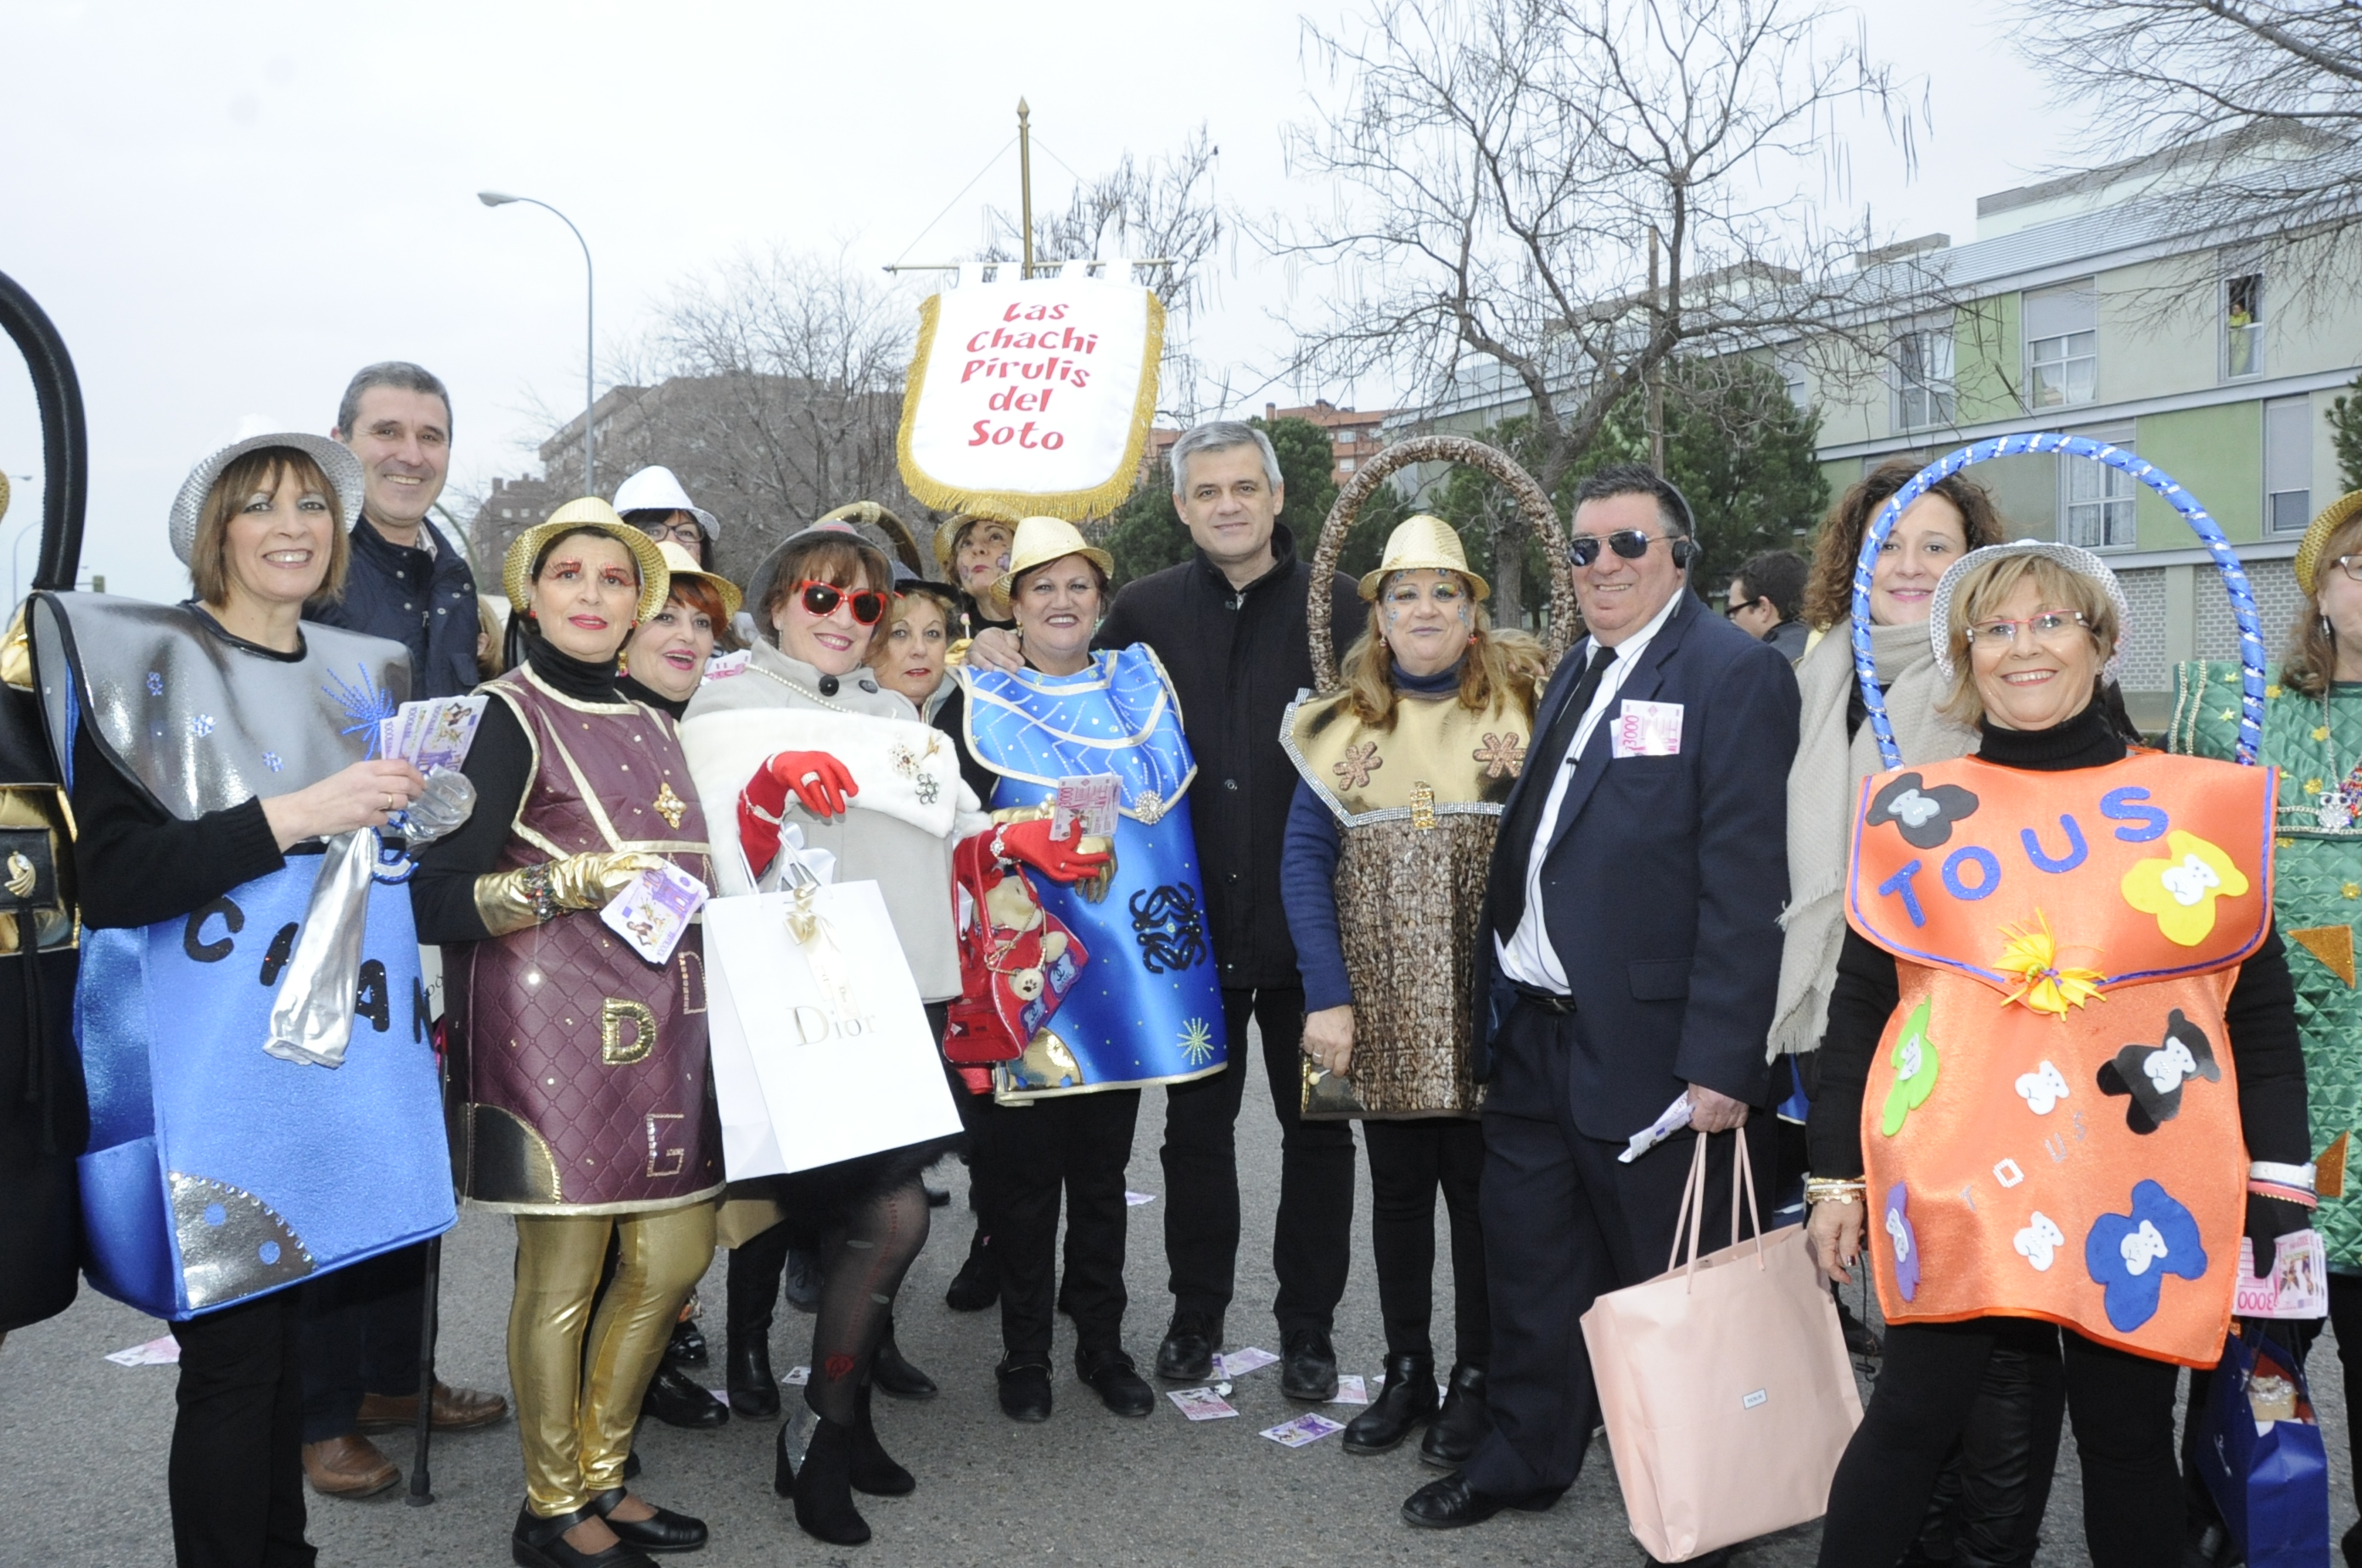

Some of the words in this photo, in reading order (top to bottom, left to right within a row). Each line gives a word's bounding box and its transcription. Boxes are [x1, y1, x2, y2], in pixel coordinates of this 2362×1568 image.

[1003, 302, 1070, 322] Las
[988, 385, 1054, 412] del
[968, 419, 1064, 451] Soto
[1623, 715, 1639, 746] 3000
[1878, 787, 2169, 928] TOUS
[602, 997, 657, 1065] D
[786, 1005, 877, 1047] Dior
[1958, 1111, 2087, 1213] TOUS
